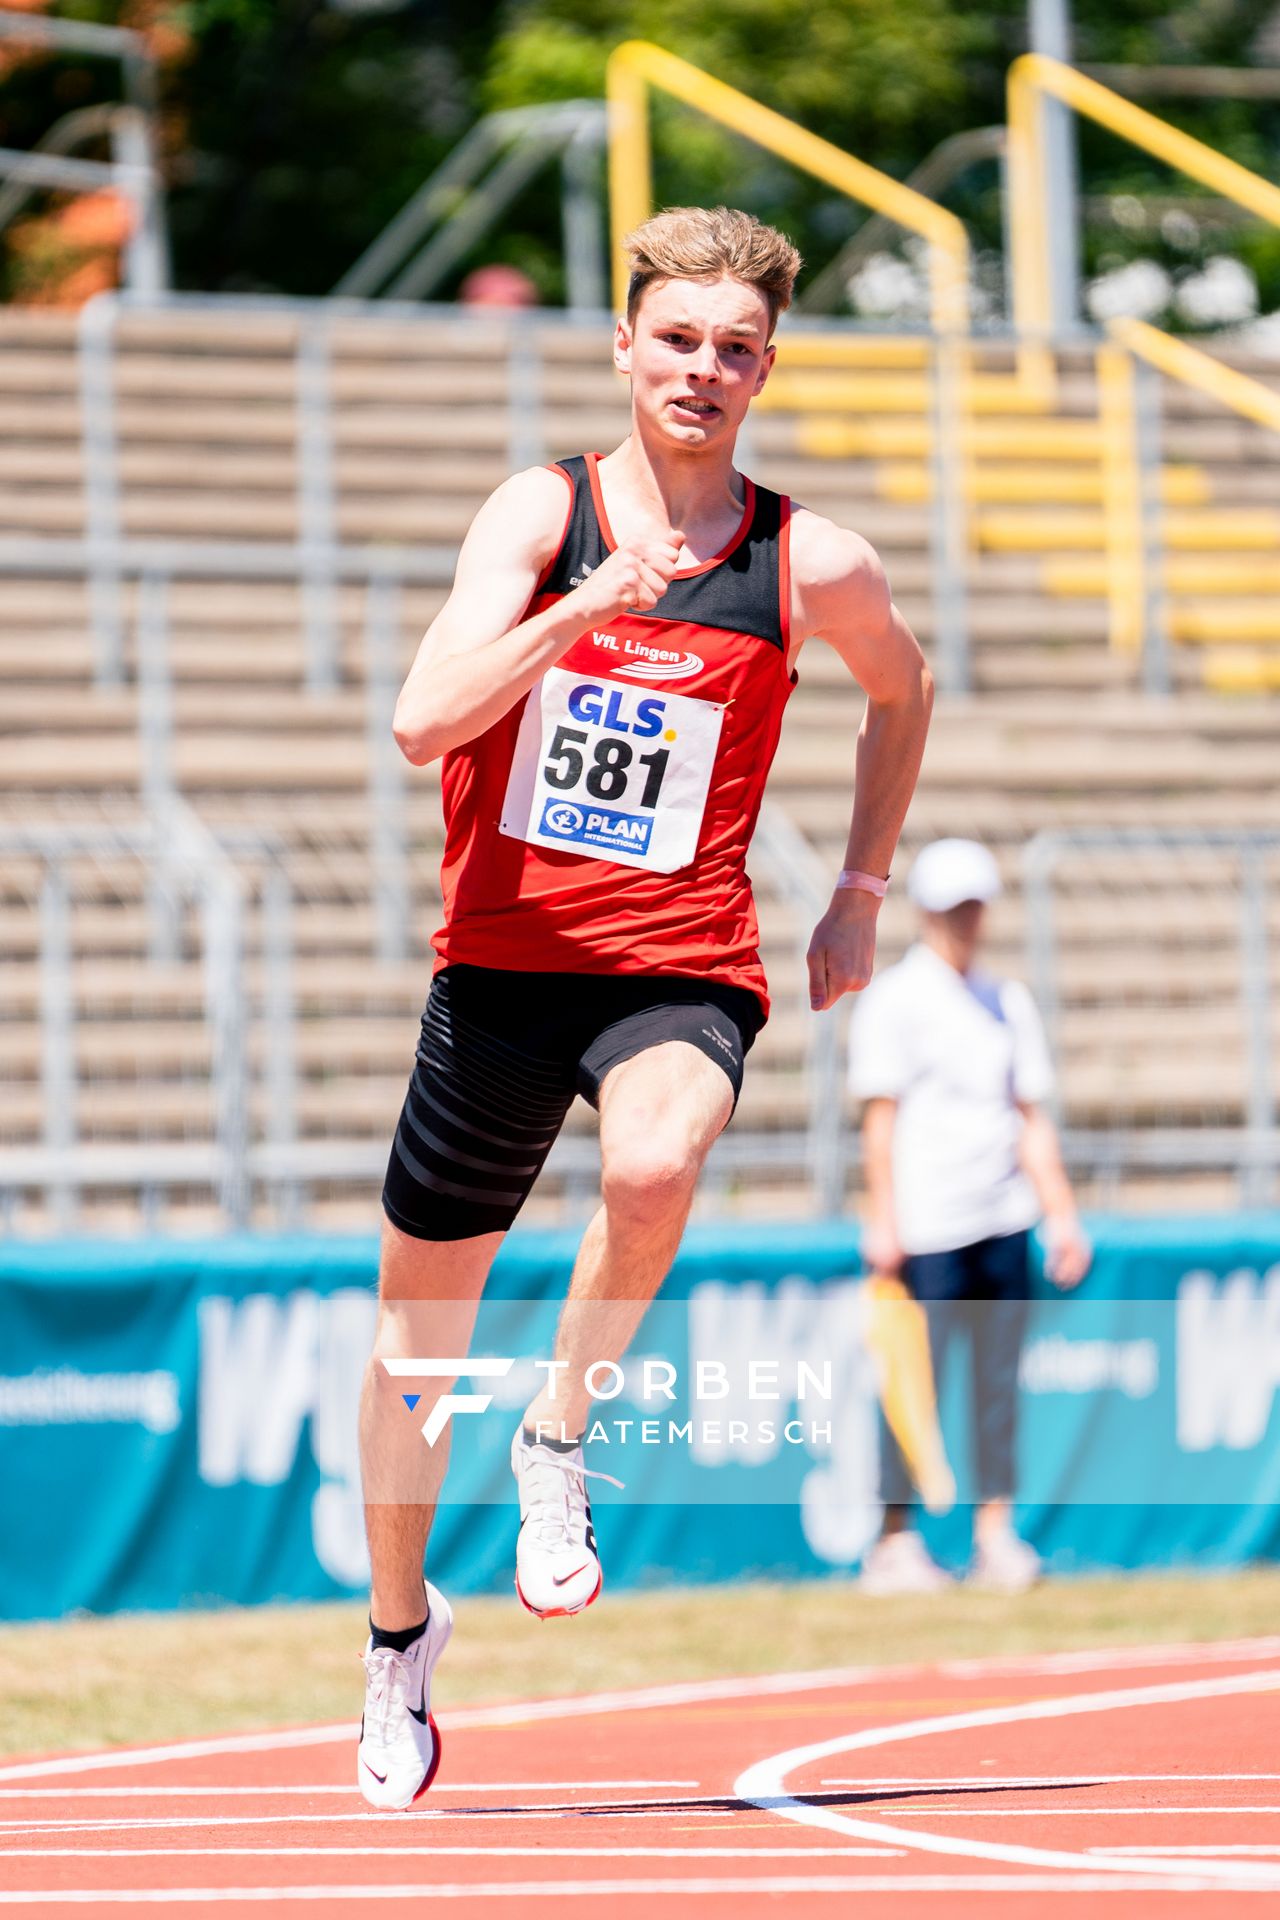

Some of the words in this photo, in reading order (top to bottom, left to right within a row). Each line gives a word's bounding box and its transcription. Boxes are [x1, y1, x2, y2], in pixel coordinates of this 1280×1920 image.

[592, 631, 620, 651] VfL
[623, 639, 680, 663] Lingen
[543, 725, 671, 810] 581
[583, 832, 644, 851] INTERNATIONAL
[585, 813, 649, 842] PLAN
